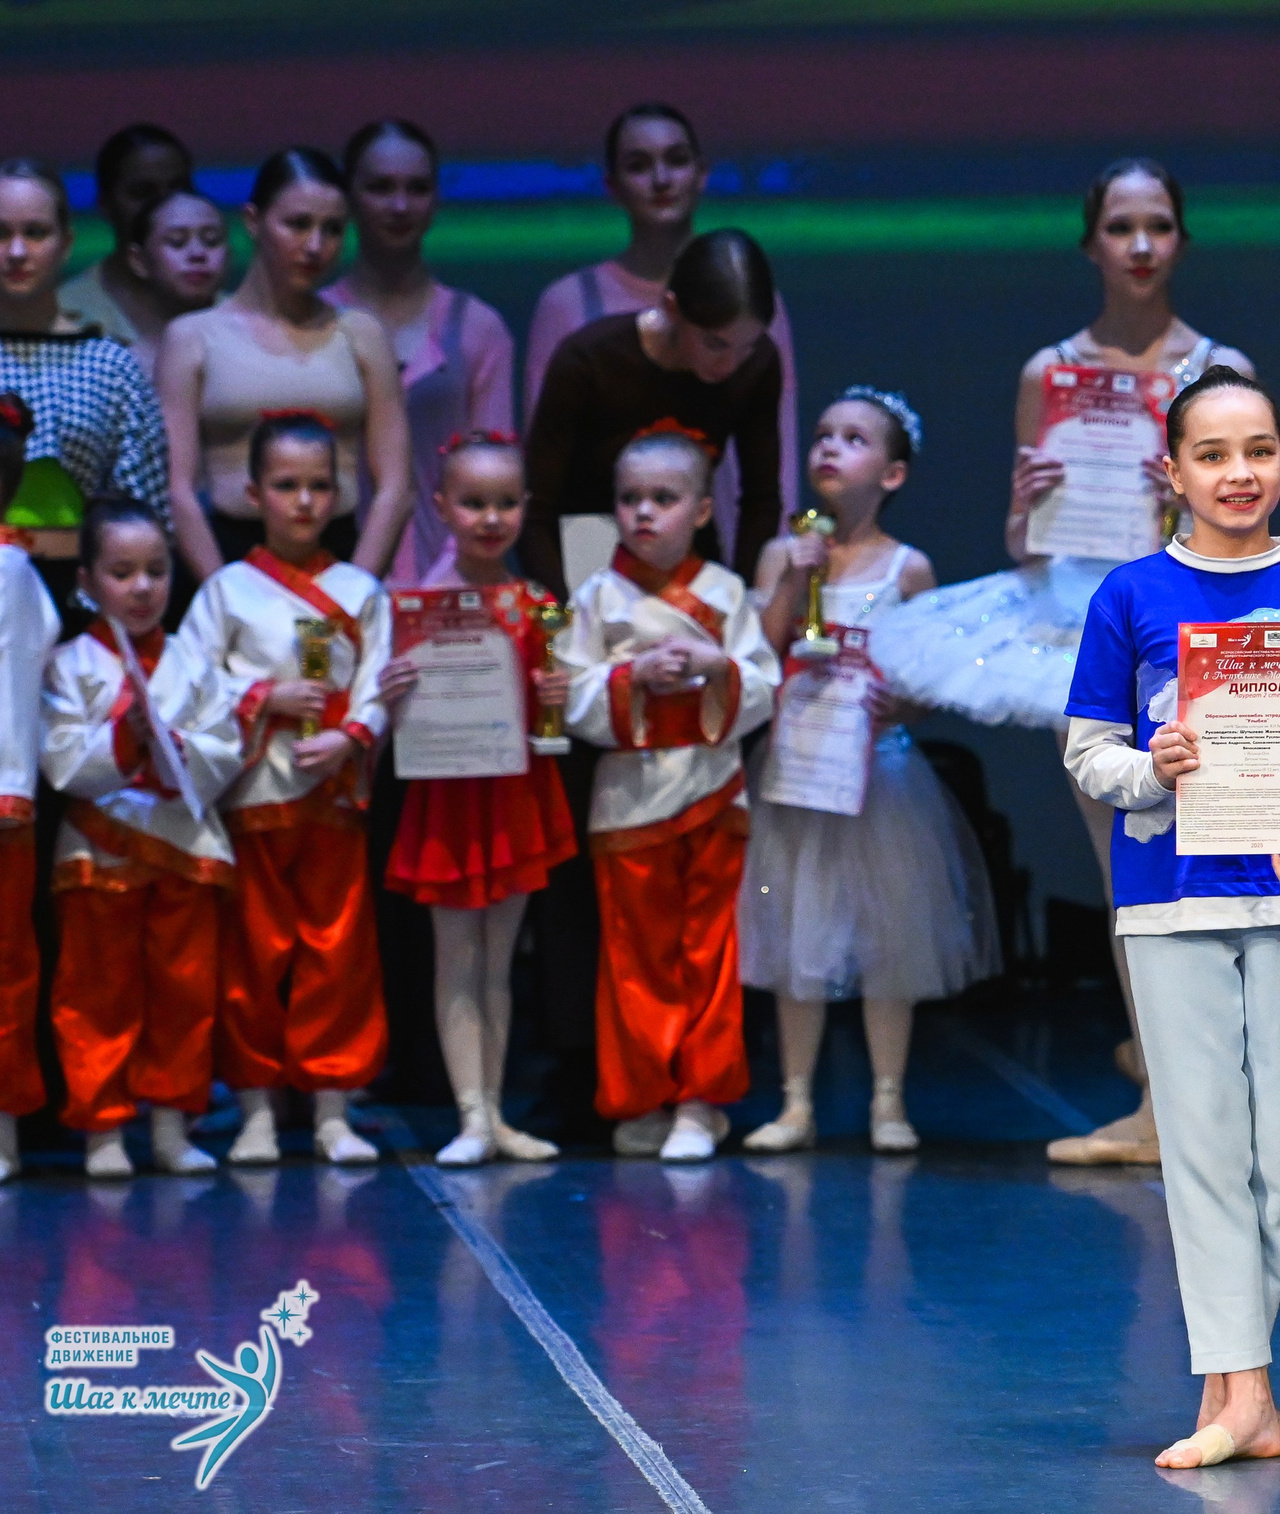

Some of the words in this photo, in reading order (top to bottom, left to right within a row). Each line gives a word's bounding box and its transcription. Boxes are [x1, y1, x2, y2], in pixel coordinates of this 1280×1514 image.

[1215, 659, 1244, 670] Шаг
[1203, 671, 1210, 680] в
[1212, 671, 1262, 682] Республике
